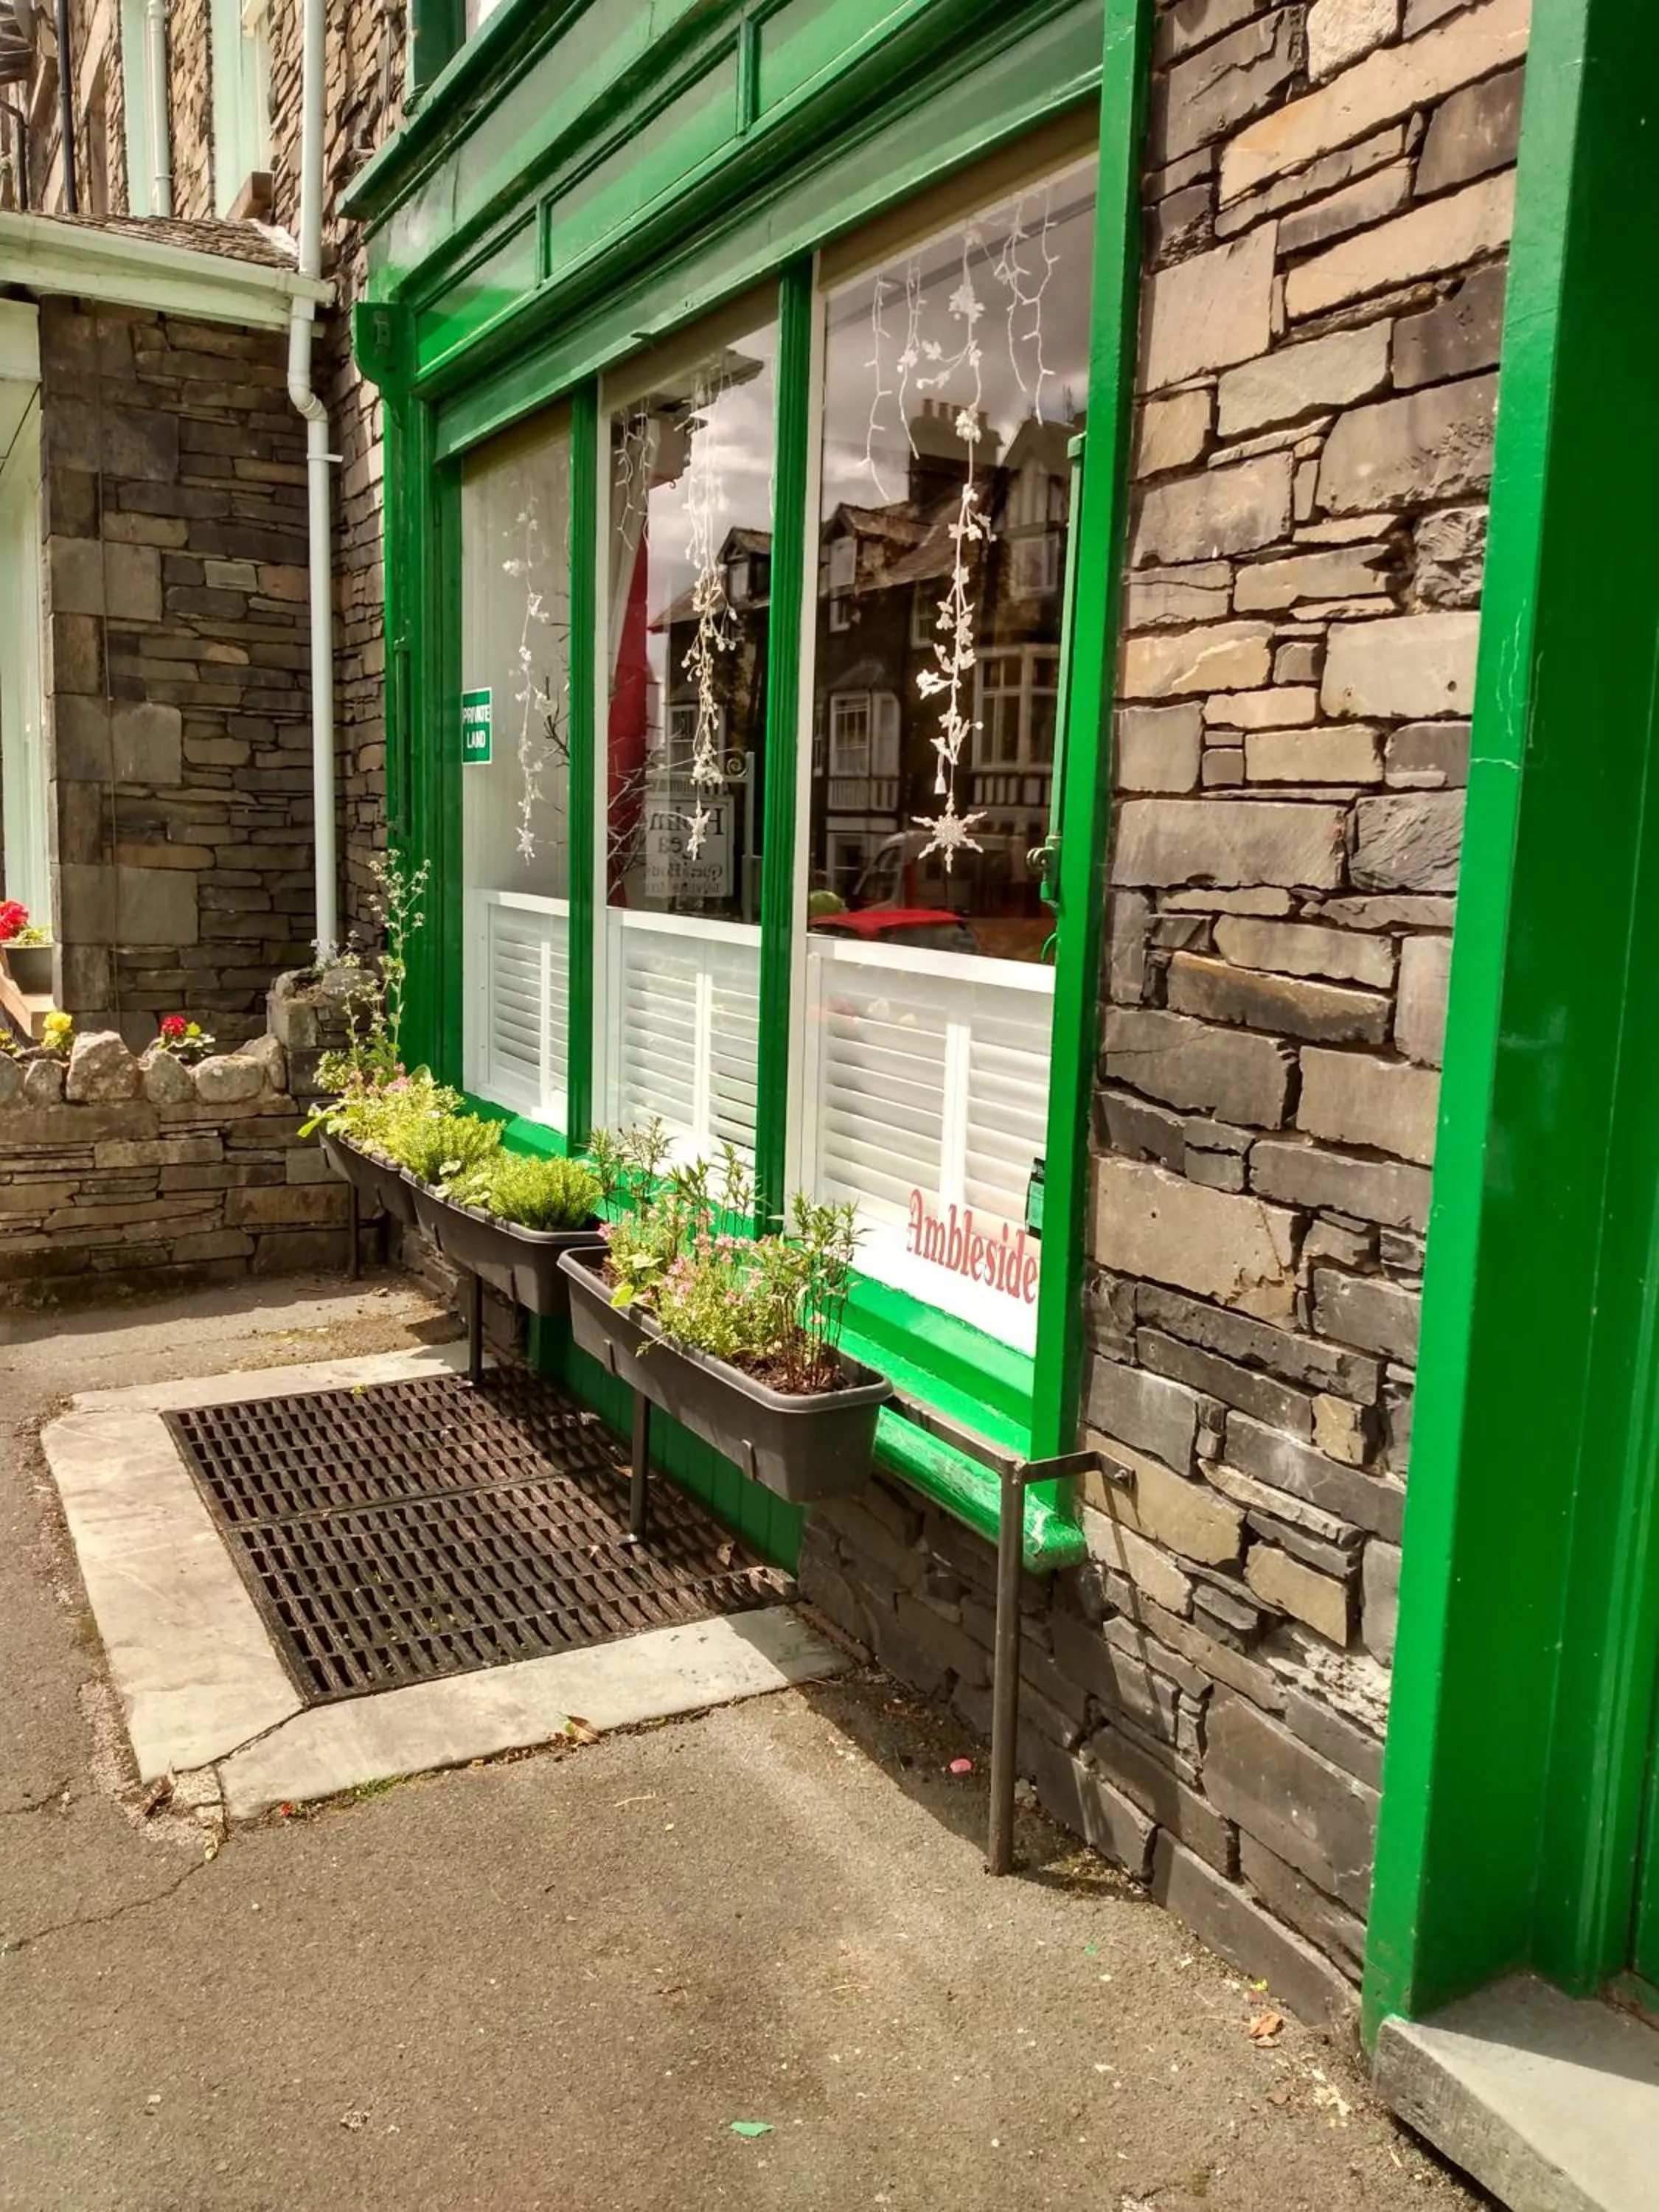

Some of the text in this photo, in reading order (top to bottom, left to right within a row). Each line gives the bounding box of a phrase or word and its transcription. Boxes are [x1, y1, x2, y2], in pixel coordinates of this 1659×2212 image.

[463, 705, 490, 723] PRIVATE
[467, 730, 487, 748] LAND
[906, 1189, 1037, 1304] Ambleside
